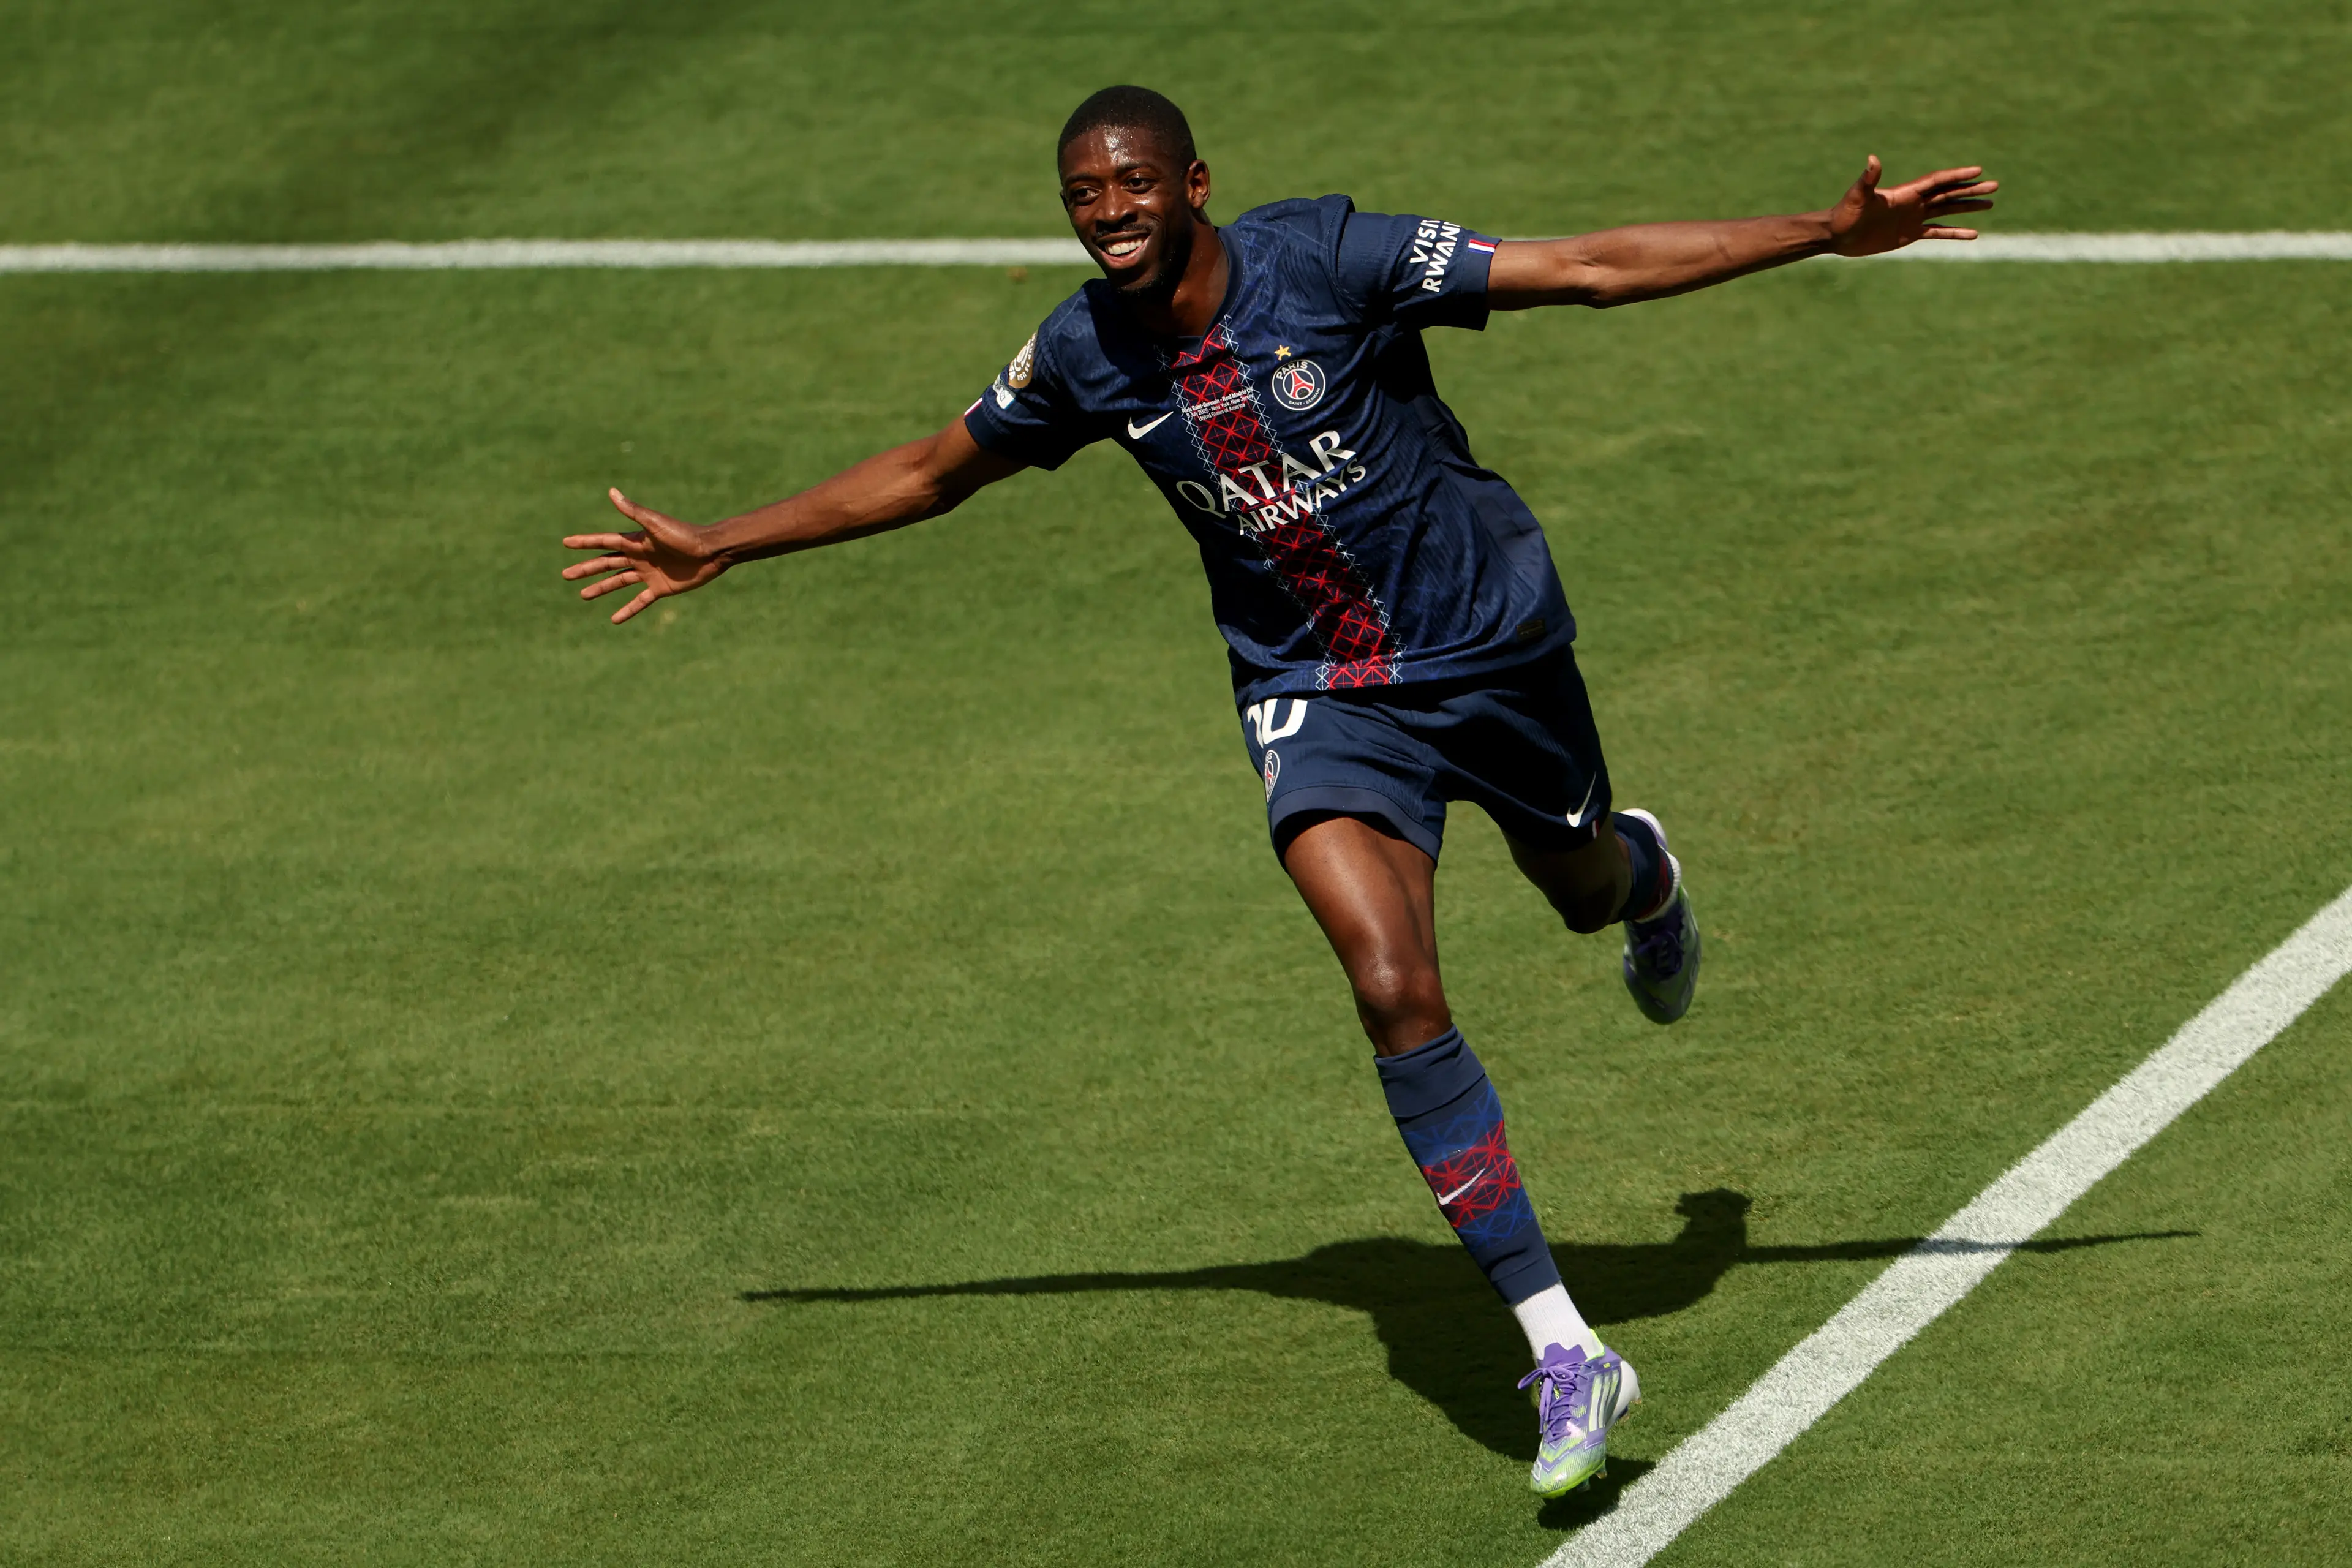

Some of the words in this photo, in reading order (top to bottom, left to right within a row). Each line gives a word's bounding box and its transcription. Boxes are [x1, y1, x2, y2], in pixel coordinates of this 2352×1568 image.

[1422, 222, 1461, 292] RWAN
[1276, 361, 1308, 380] PARIS
[1231, 389, 1247, 398] Madrid
[1305, 387, 1321, 404] GERMAIN
[1198, 413, 1212, 421] United
[1229, 403, 1246, 412] America
[1176, 431, 1356, 519] QATAR
[1240, 458, 1366, 535] AIRWAYS
[1247, 698, 1308, 749] 10
